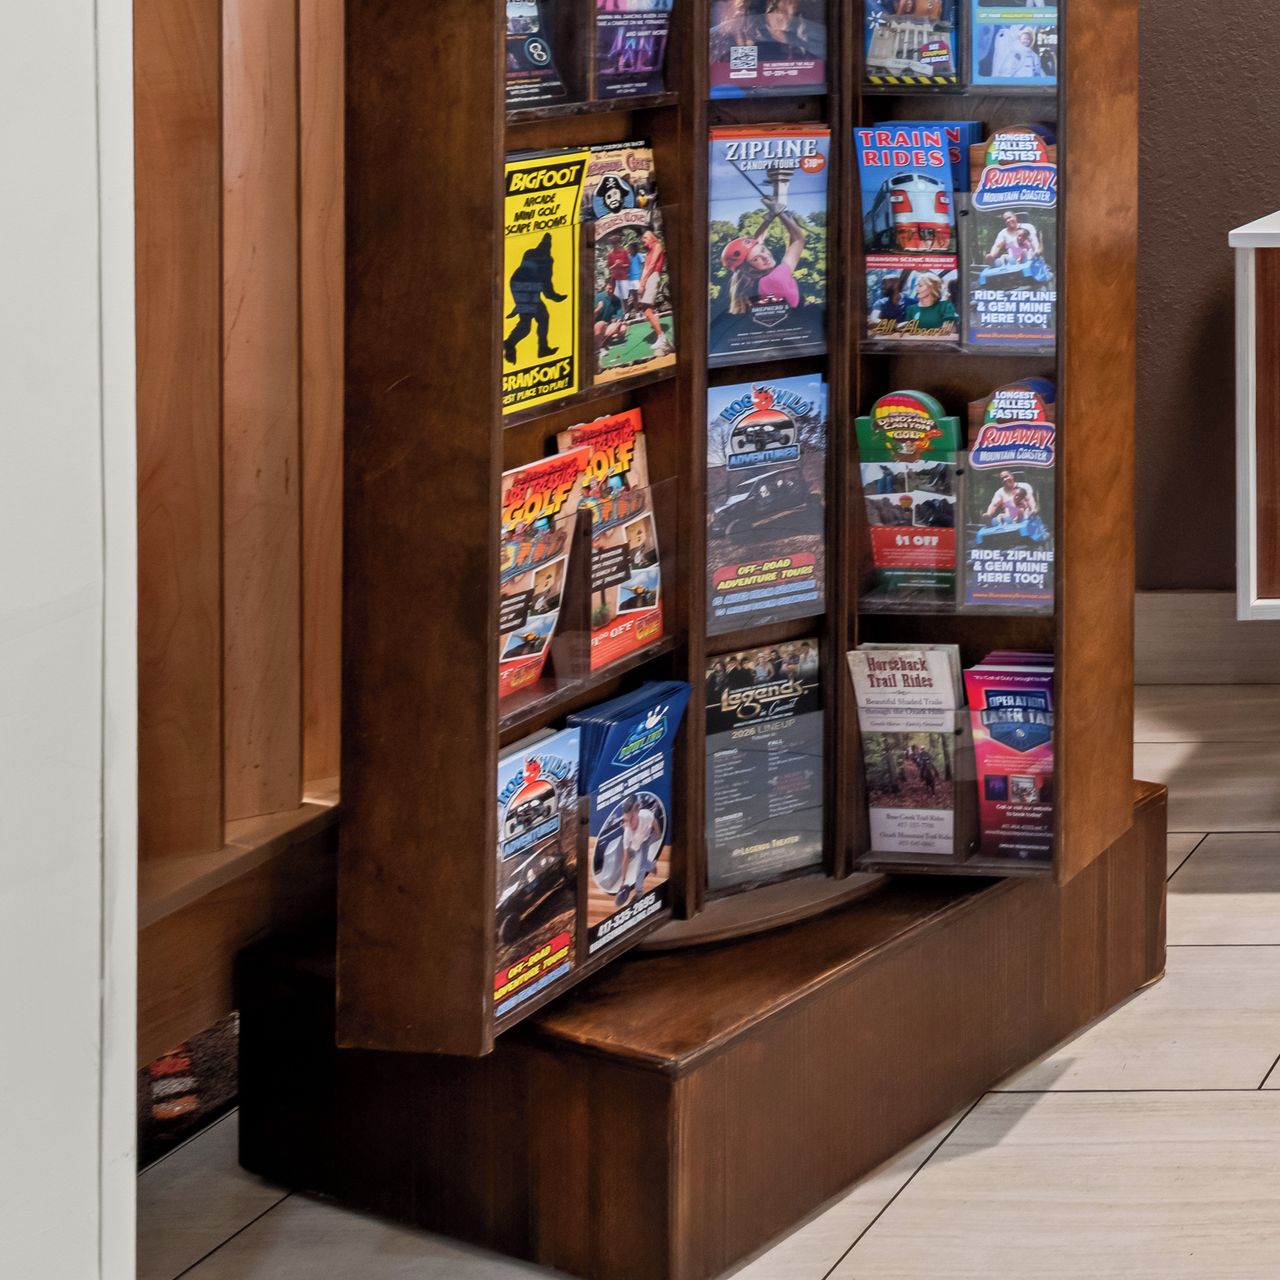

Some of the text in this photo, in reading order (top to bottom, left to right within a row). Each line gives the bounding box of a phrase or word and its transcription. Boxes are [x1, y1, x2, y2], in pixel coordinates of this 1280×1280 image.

[922, 50, 948, 58] COUPON
[859, 130, 942, 147] TRAIN
[995, 133, 1036, 141] LONGEST
[725, 138, 817, 162] ZIPLINE
[993, 141, 1038, 152] TALLEST
[864, 150, 945, 167] RIDES
[991, 150, 1042, 162] FASTEST
[741, 158, 800, 171] CANOPY TOURS
[509, 165, 581, 192] BIGFOOT
[523, 193, 556, 207] ARCADE
[513, 204, 560, 222] MINI GOLF
[505, 215, 567, 236] SCAPE ROOMS
[974, 290, 1057, 304] RIDE, ZIPLINE
[977, 302, 1052, 313] & GEM MINE
[981, 312, 1048, 324] HERE TOO!
[502, 359, 571, 392] BRANSON'S
[995, 391, 1035, 400] LONGEST
[720, 393, 752, 422] HOG
[992, 399, 1037, 410] TALLEST
[990, 408, 1041, 420] FASTEST
[530, 467, 578, 493] TREASURE
[504, 483, 530, 506] LOST
[502, 480, 576, 531] GOLF
[896, 535, 939, 546] $1 OFF
[971, 549, 1005, 563] RIDE,
[1007, 549, 1054, 562] ZIPLINE
[737, 558, 792, 576] OFF-ROAD
[973, 561, 1049, 572] & GEM MINE
[717, 565, 814, 591] ADVENTURE TOURS
[977, 572, 1044, 584] HERE TOO!
[609, 620, 634, 637] OFF
[867, 657, 928, 672] Horseback
[867, 673, 933, 689] Trail Rides
[721, 679, 804, 719] Legends
[988, 694, 1046, 708] OPERATION
